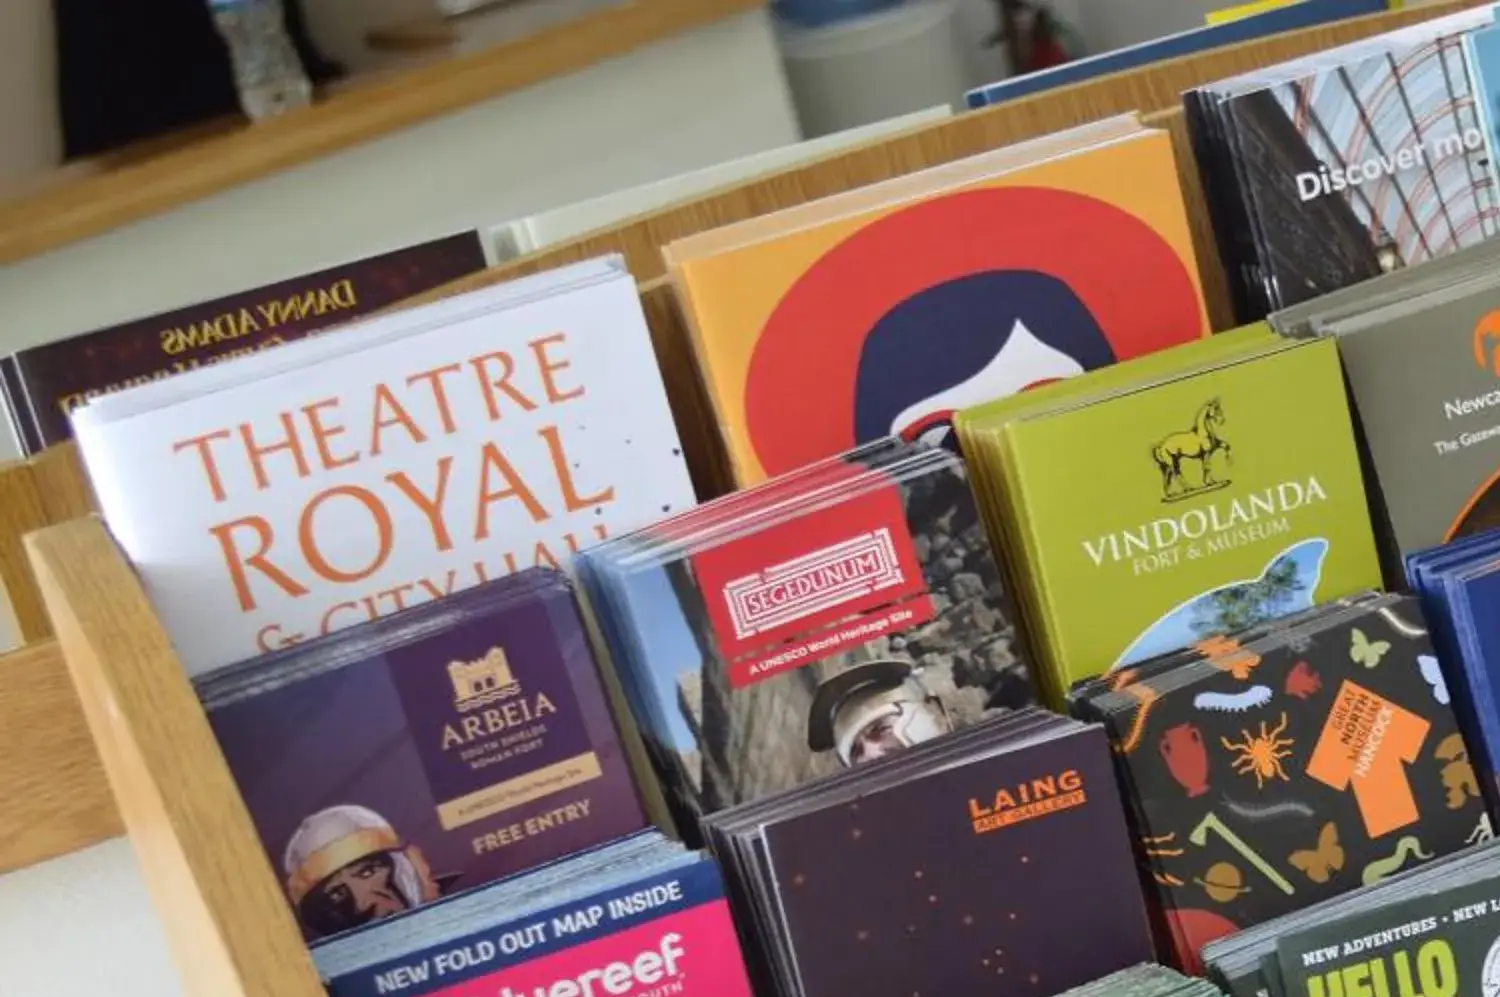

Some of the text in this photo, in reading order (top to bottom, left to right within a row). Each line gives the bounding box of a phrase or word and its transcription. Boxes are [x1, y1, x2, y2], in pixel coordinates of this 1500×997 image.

[1295, 129, 1483, 201] Discover mo
[172, 332, 585, 503] THEATRE
[1433, 438, 1459, 456] The
[208, 425, 615, 614] ROYAL
[1081, 475, 1328, 567] VINDOLANDA
[1132, 516, 1291, 577] FORT & MUSEUM
[749, 551, 879, 615] SEGEDUNUM
[749, 662, 760, 676] A
[441, 691, 558, 751] ARBEIA
[1340, 692, 1370, 746] NORTH
[1353, 705, 1395, 779] HANCOCK
[967, 769, 1083, 819] LAING
[471, 798, 592, 855] FREE ENTRY
[373, 879, 684, 995] NEW FOLD OUT MAP INSIDE
[1301, 945, 1341, 967] NEW
[1342, 915, 1438, 956] ADVENTURES
[1452, 900, 1488, 924] NEW
